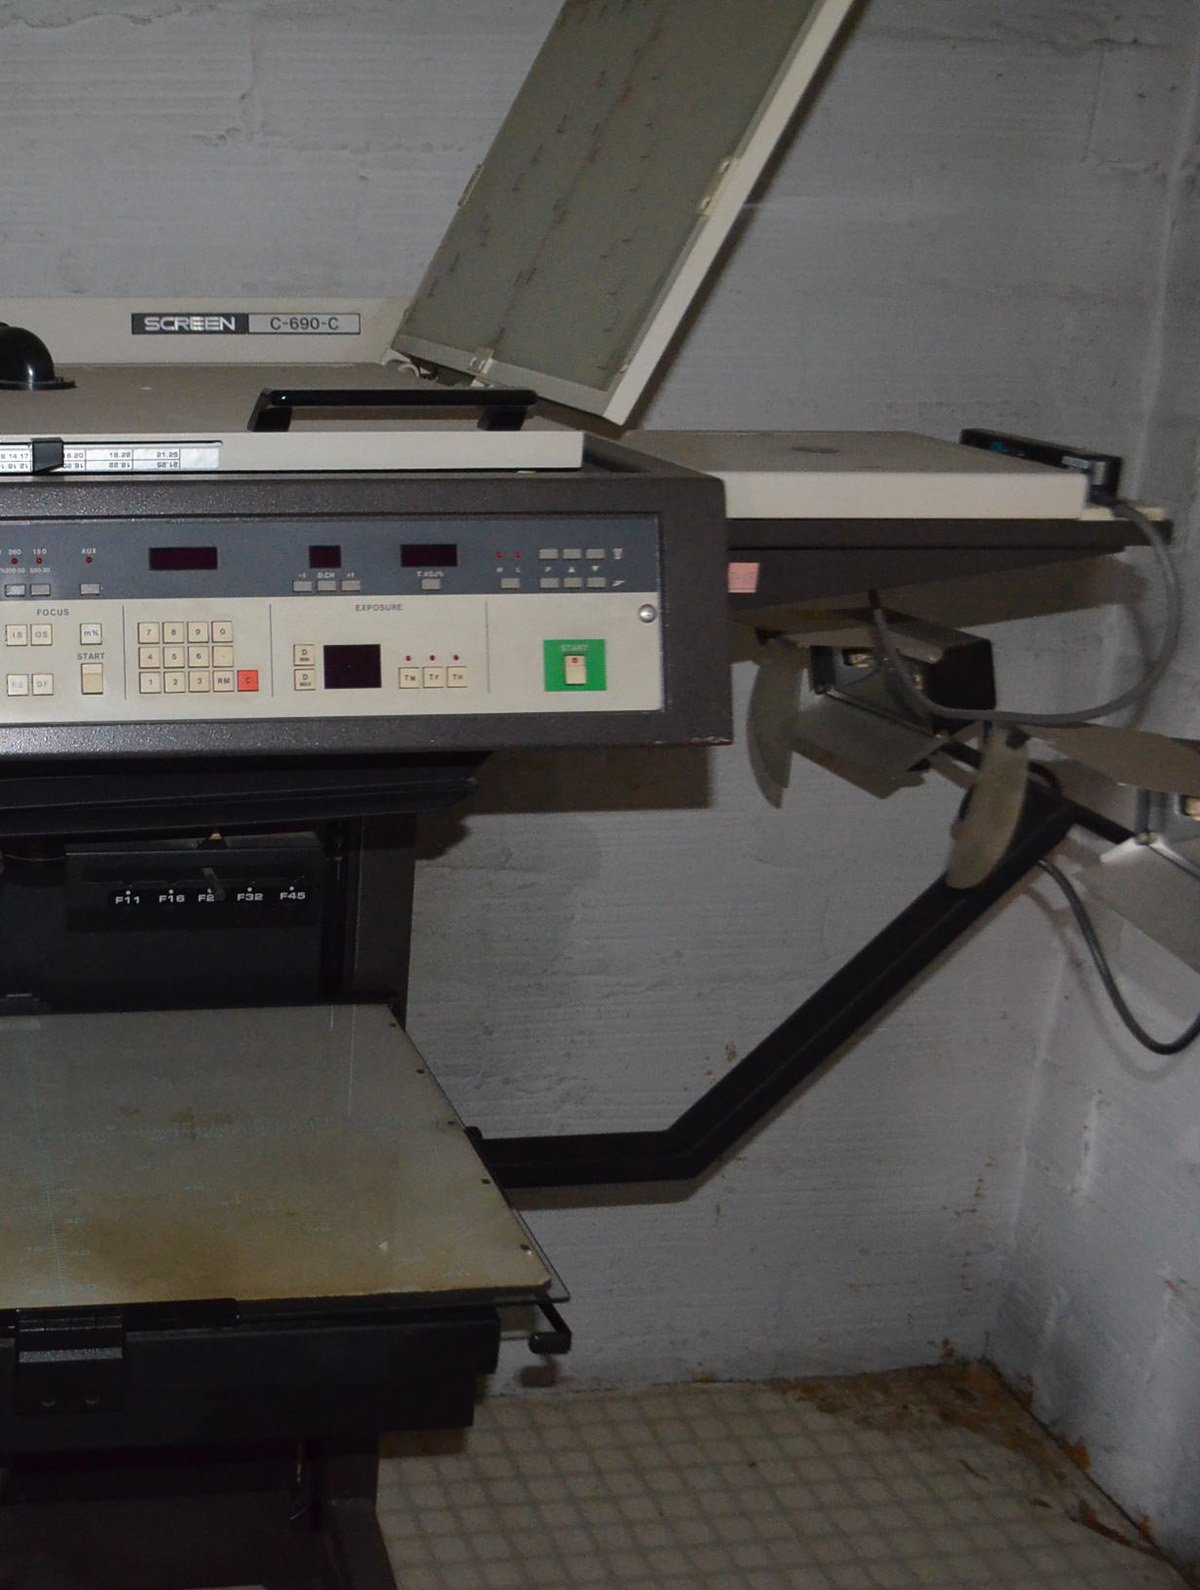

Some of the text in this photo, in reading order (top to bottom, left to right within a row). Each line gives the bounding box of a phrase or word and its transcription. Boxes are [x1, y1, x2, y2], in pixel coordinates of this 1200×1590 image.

[144, 316, 340, 331] SCREEN C-690-C
[355, 603, 404, 611] EXPOSURE
[36, 608, 70, 616] FOCUS
[171, 628, 176, 636] 8
[77, 652, 105, 661] START
[173, 678, 178, 686] 2
[159, 894, 185, 903] F16
[237, 892, 263, 901] F32
[280, 891, 306, 900] F45
